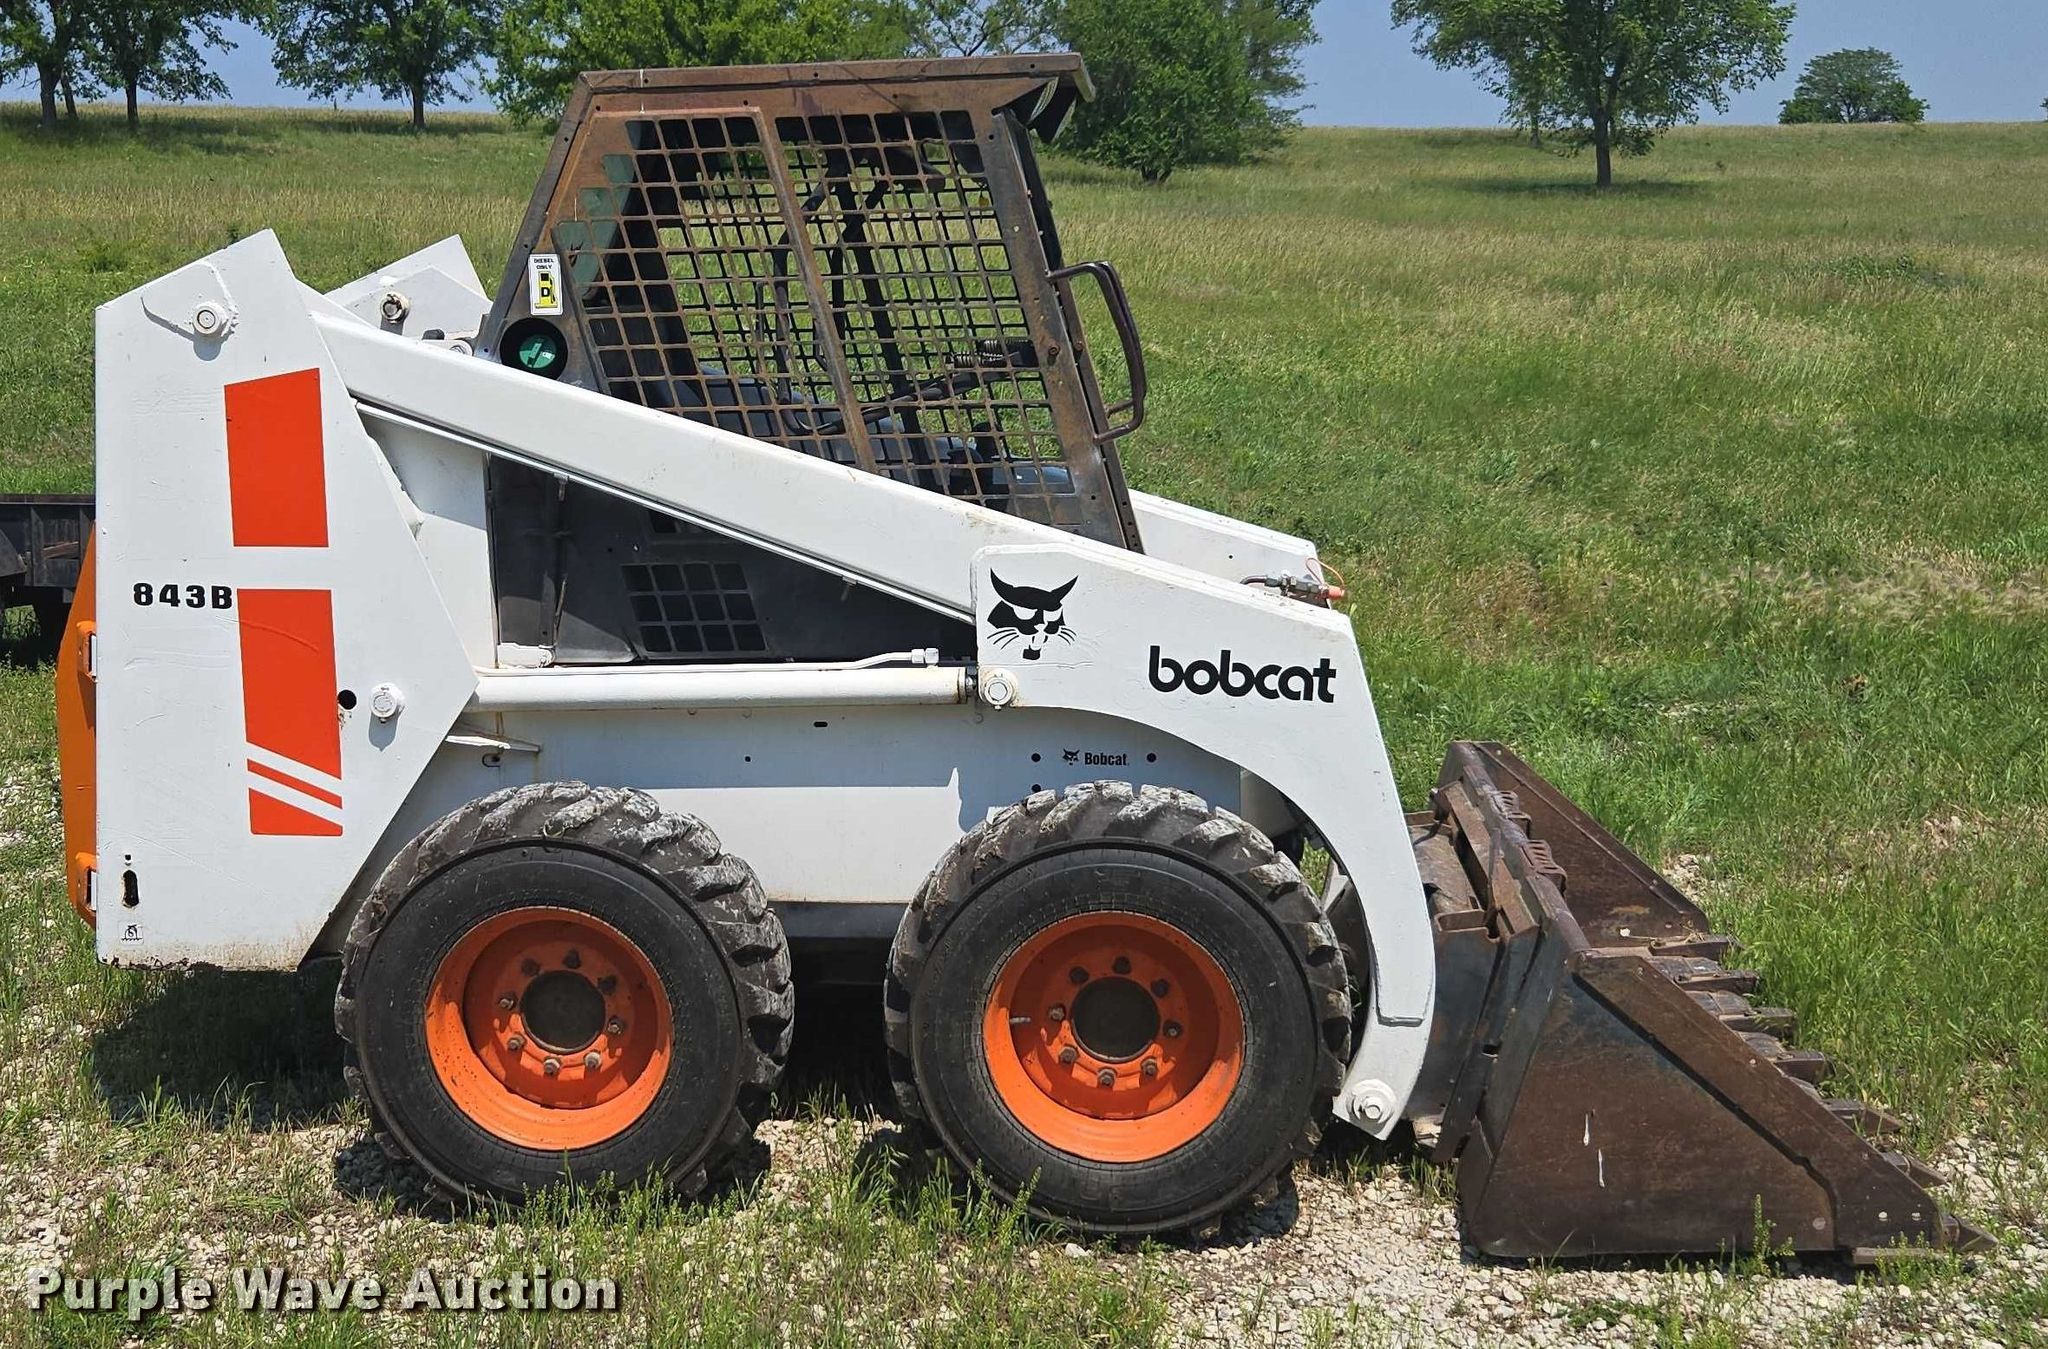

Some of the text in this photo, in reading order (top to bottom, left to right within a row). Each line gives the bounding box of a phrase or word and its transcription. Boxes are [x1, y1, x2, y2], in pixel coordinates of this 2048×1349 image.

[541, 287, 551, 297] D
[133, 582, 233, 610] 843B
[1148, 645, 1337, 703] bobcat
[1084, 752, 1127, 766] Bobcat
